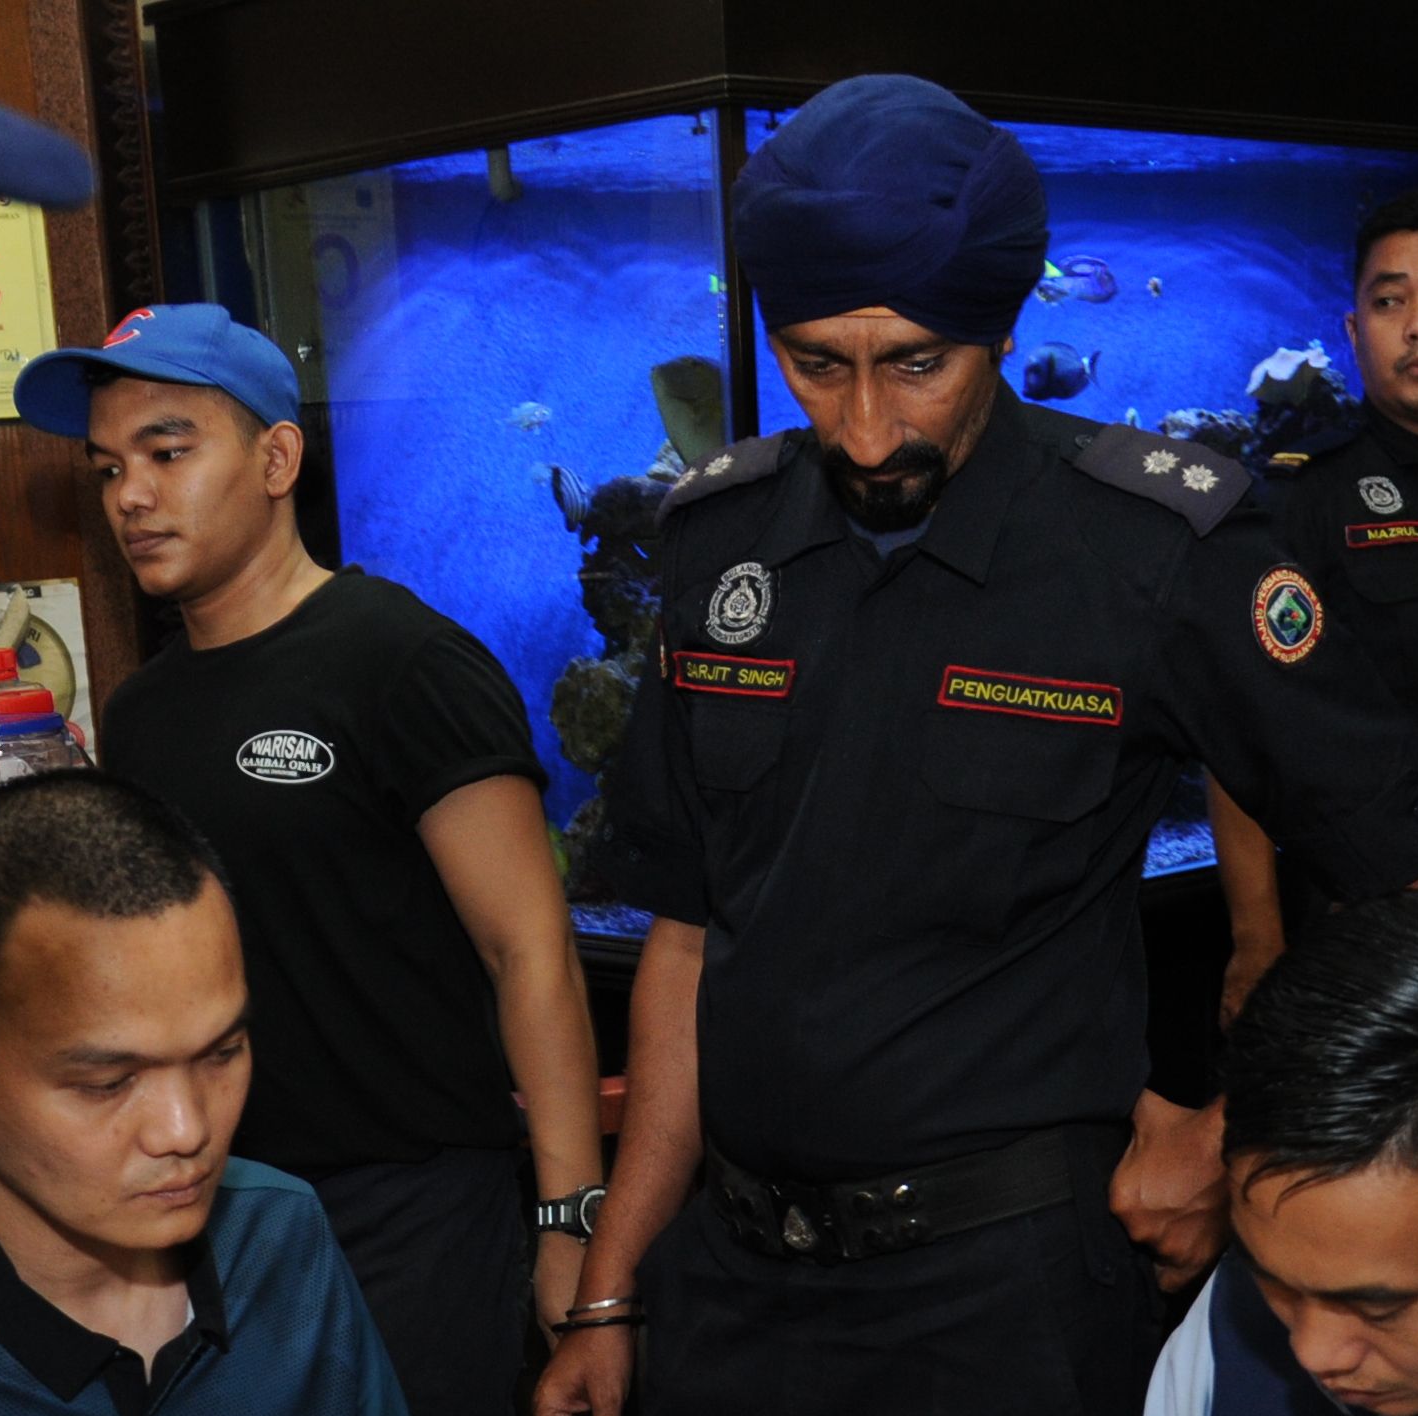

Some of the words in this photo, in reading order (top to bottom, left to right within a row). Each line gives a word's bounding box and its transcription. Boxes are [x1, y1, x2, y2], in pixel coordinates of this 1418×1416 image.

[686, 661, 729, 682] SARJIT
[737, 667, 785, 687] SINGH
[949, 678, 1114, 716] PENGUATKUASA
[251, 735, 317, 760] WARISAN
[242, 758, 286, 768] SAMBAL
[289, 760, 322, 773] OPAH
